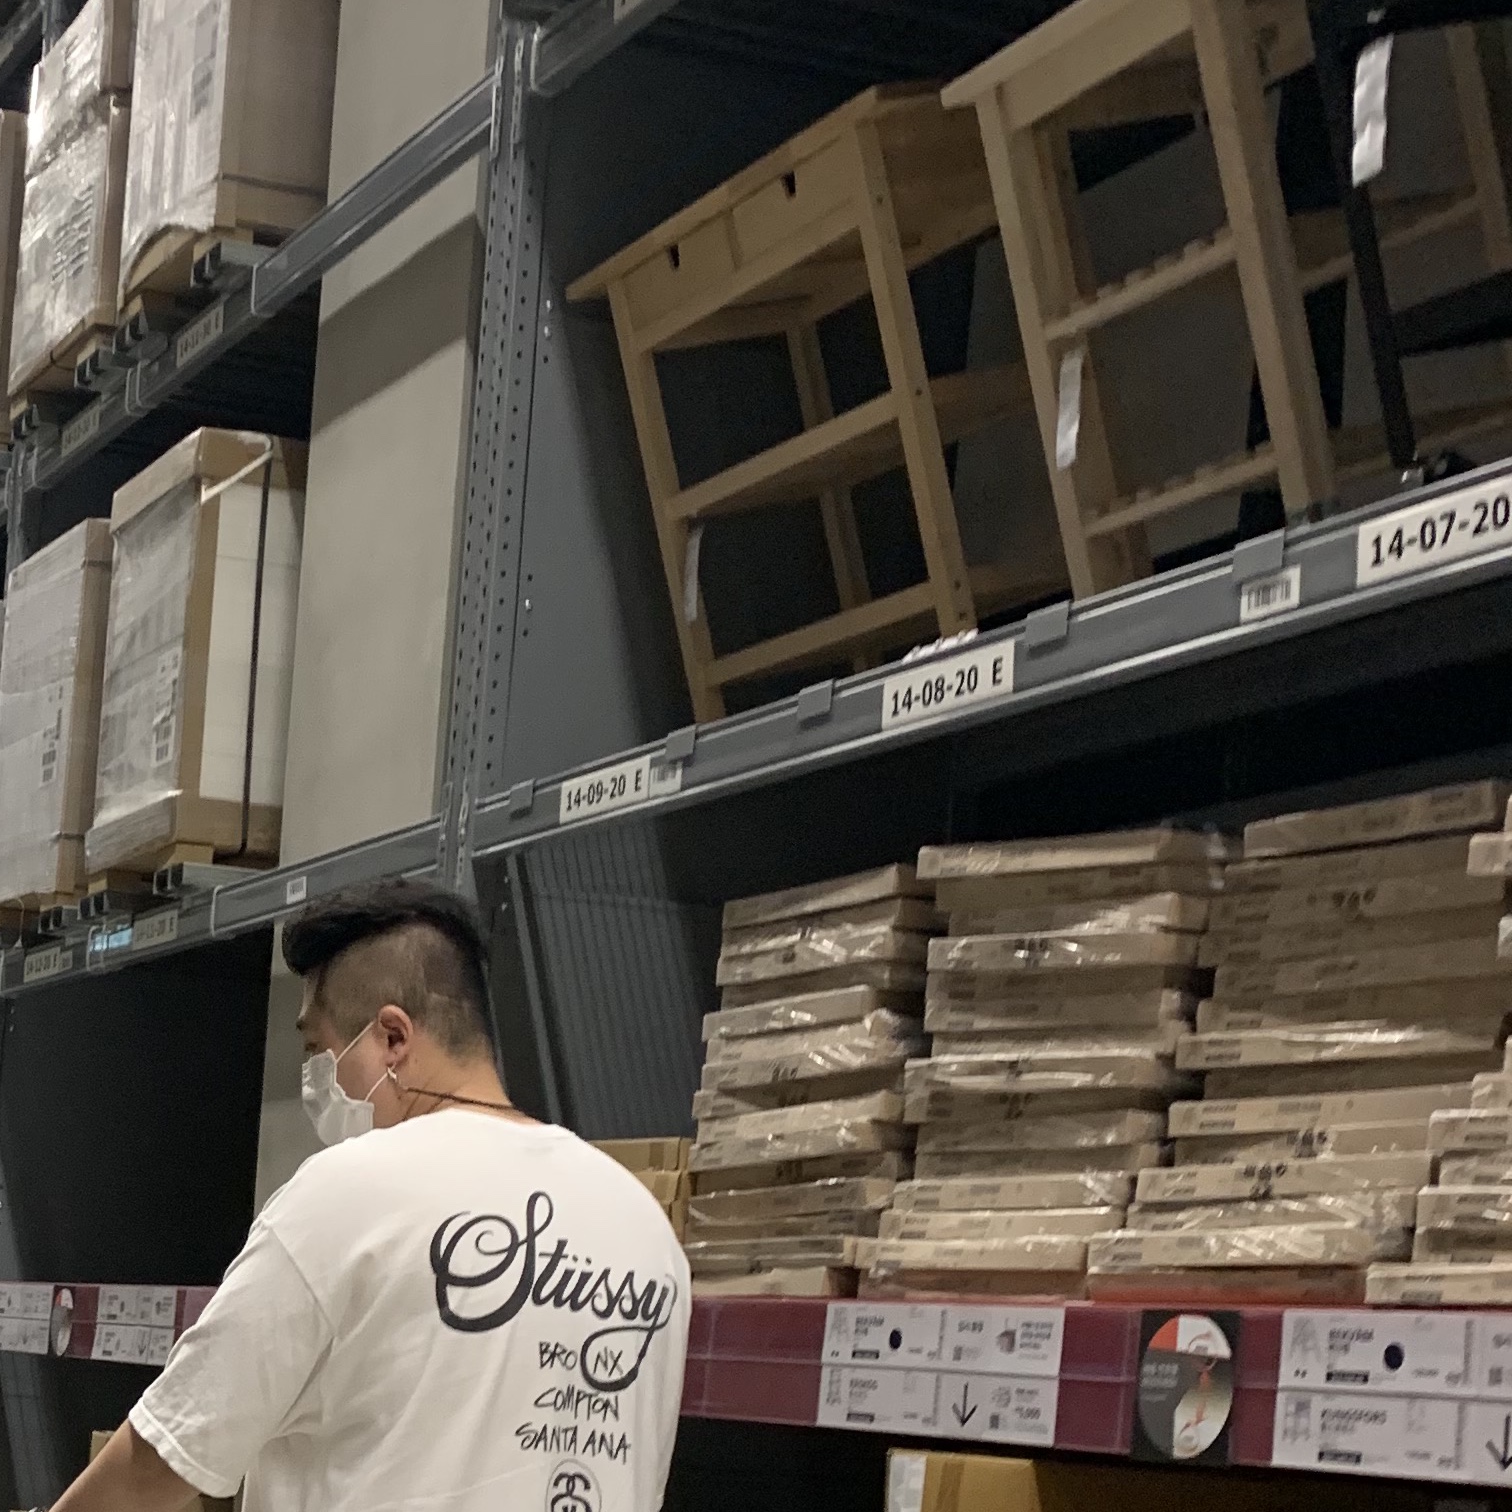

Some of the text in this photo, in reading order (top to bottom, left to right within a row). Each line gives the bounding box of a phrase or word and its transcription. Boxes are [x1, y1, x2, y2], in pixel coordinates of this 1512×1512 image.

[1371, 493, 1511, 568] 14-07-20
[891, 656, 1003, 717] 14-08-20 E
[566, 769, 643, 812] 14-09-20 E
[429, 1190, 678, 1392] Stüssy
[534, 1384, 619, 1422] COMPTON
[515, 1422, 632, 1464] SANTA ANA
